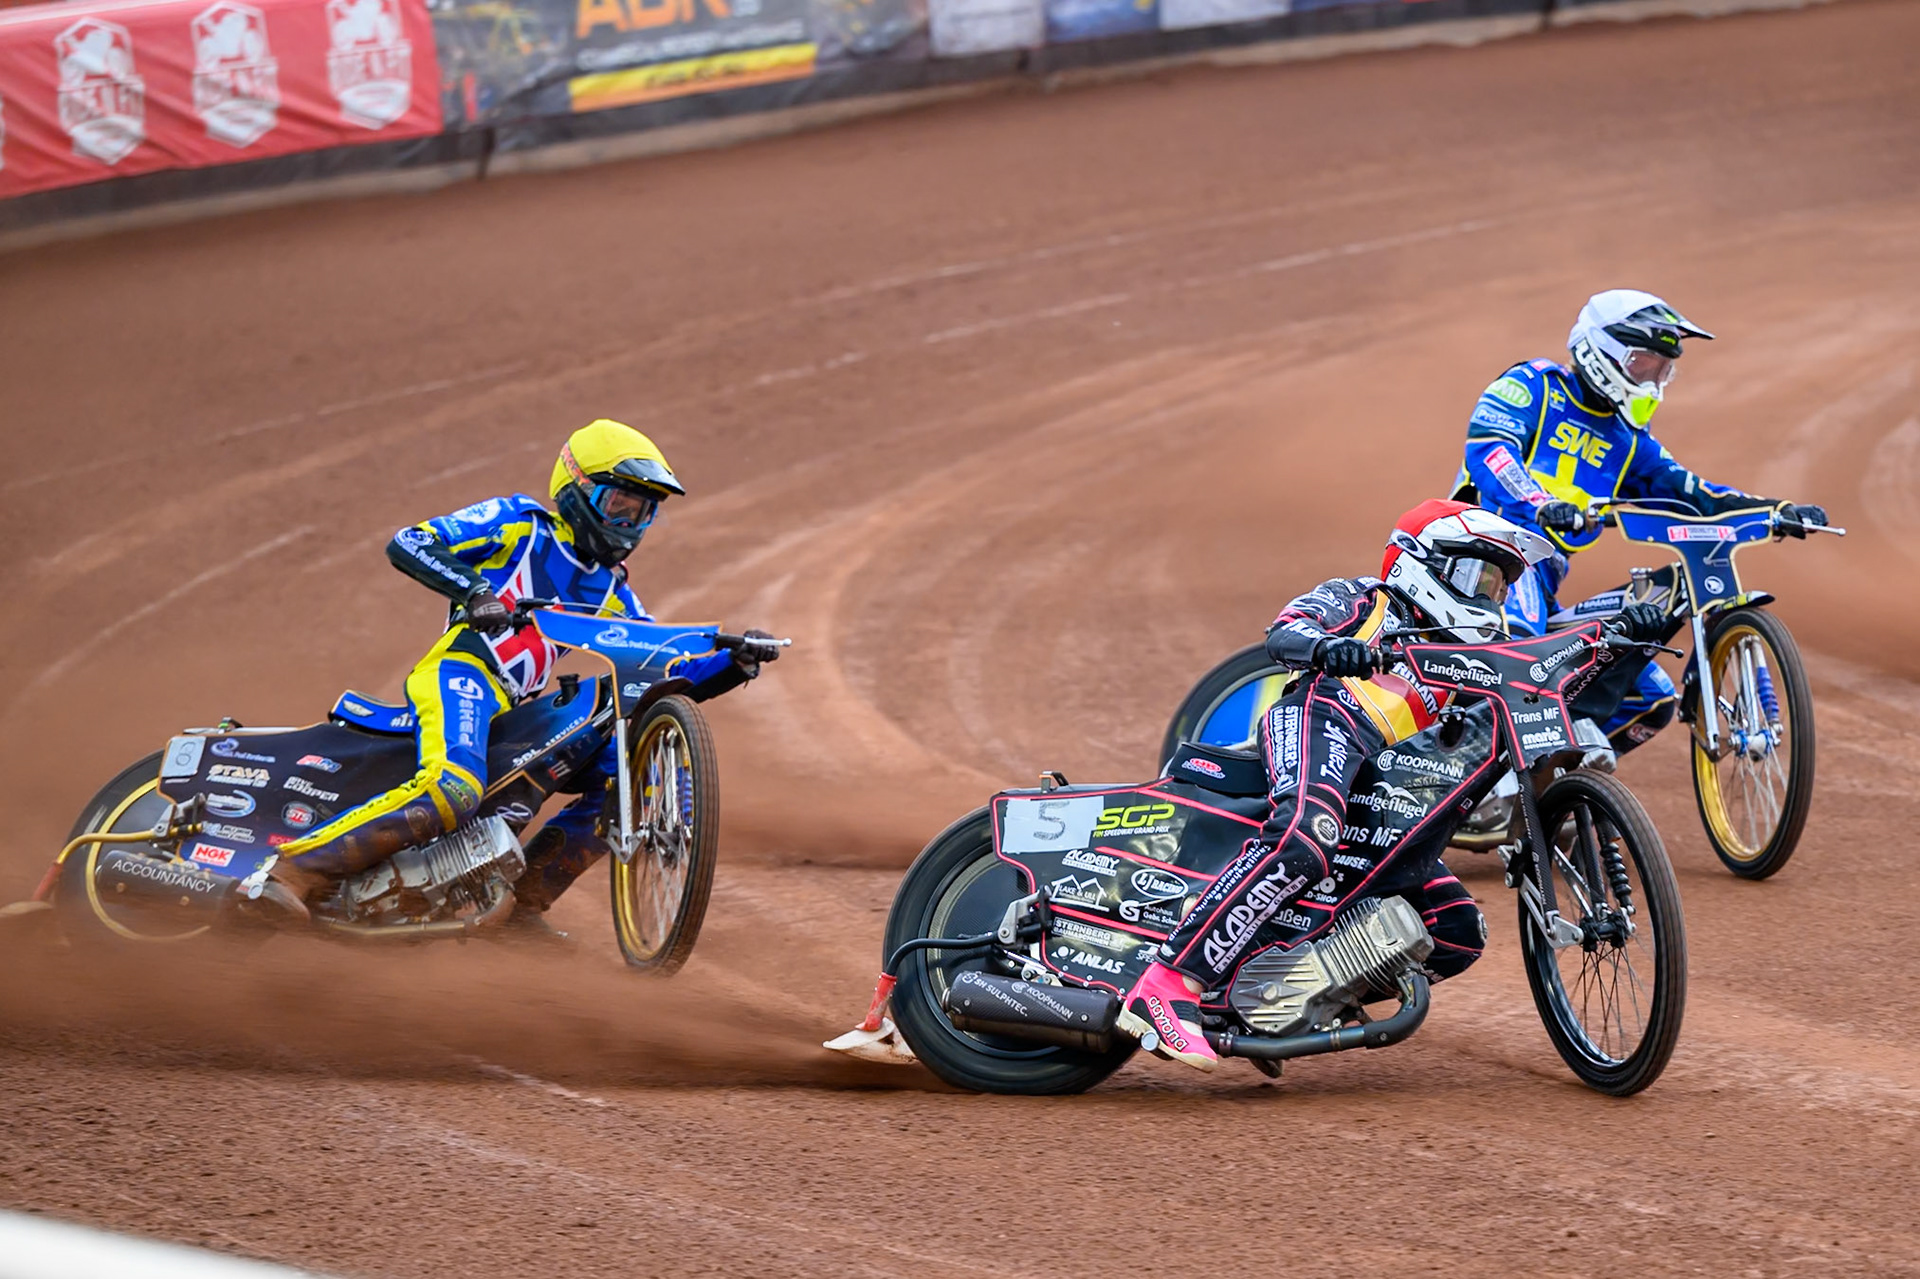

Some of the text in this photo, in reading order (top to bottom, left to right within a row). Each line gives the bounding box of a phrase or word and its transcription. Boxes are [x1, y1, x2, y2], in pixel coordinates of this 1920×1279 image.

[1548, 421, 1613, 468] SWE
[1542, 639, 1585, 670] KOOPMANN
[1424, 659, 1503, 686] Landgeflügel
[1511, 707, 1560, 725] Trans MF
[545, 716, 585, 747] SERVICES
[1396, 754, 1464, 778] KOOPMANN
[1096, 803, 1176, 830] SGP
[1350, 792, 1428, 819] andgeflügel
[1033, 801, 1071, 840] 5
[1104, 828, 1135, 837] SPEEDWAY
[1134, 826, 1155, 835] GRAND
[1155, 825, 1170, 834] PRIX
[1371, 826, 1403, 848] MF
[195, 845, 231, 861] NGK
[1064, 849, 1120, 869] ACADEMY
[112, 859, 217, 894] ACCOUNTANCY
[1204, 862, 1291, 966] ACADEMY
[1055, 919, 1111, 941] STERNBERG
[1071, 948, 1126, 975] ANLAS
[1026, 986, 1073, 1021] KOOPMANN
[1148, 996, 1188, 1051] daytona
